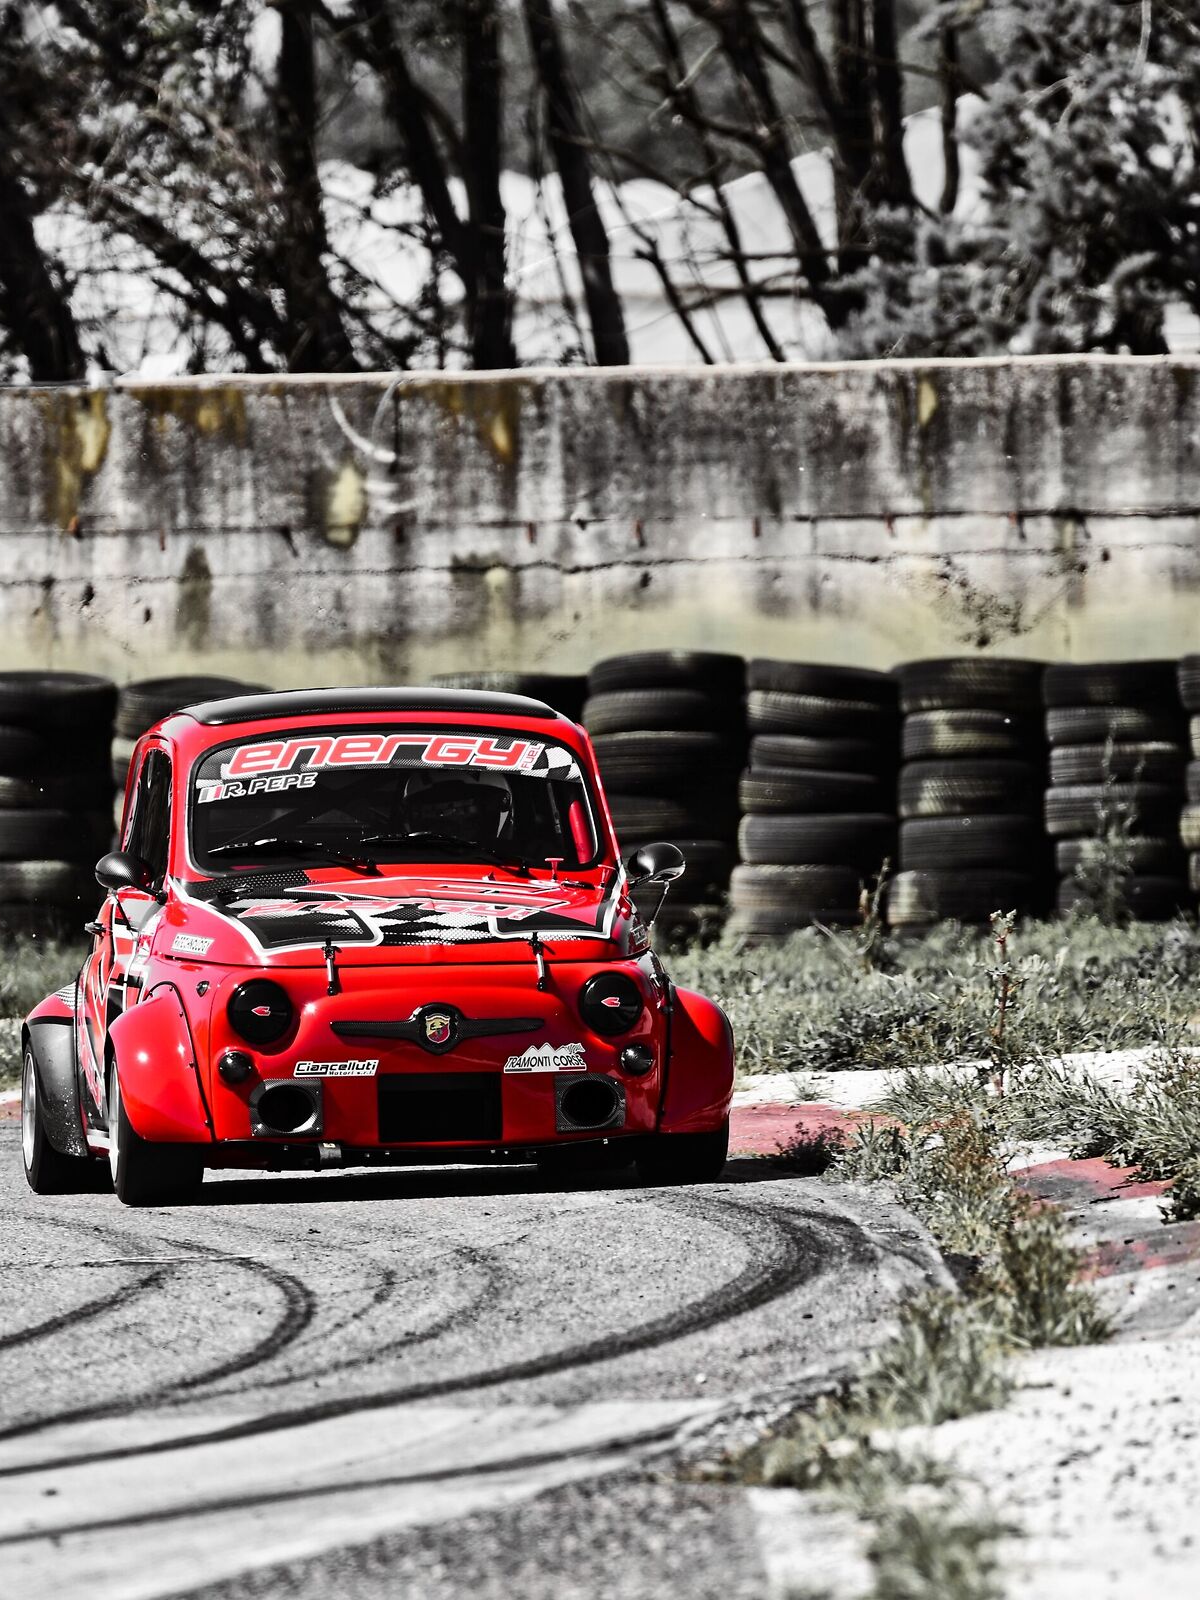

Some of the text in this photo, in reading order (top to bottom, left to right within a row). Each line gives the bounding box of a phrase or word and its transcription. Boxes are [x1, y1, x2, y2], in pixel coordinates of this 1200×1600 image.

[223, 773, 317, 799] R. PEPE
[505, 1055, 586, 1068] TRAMONTI CORSE
